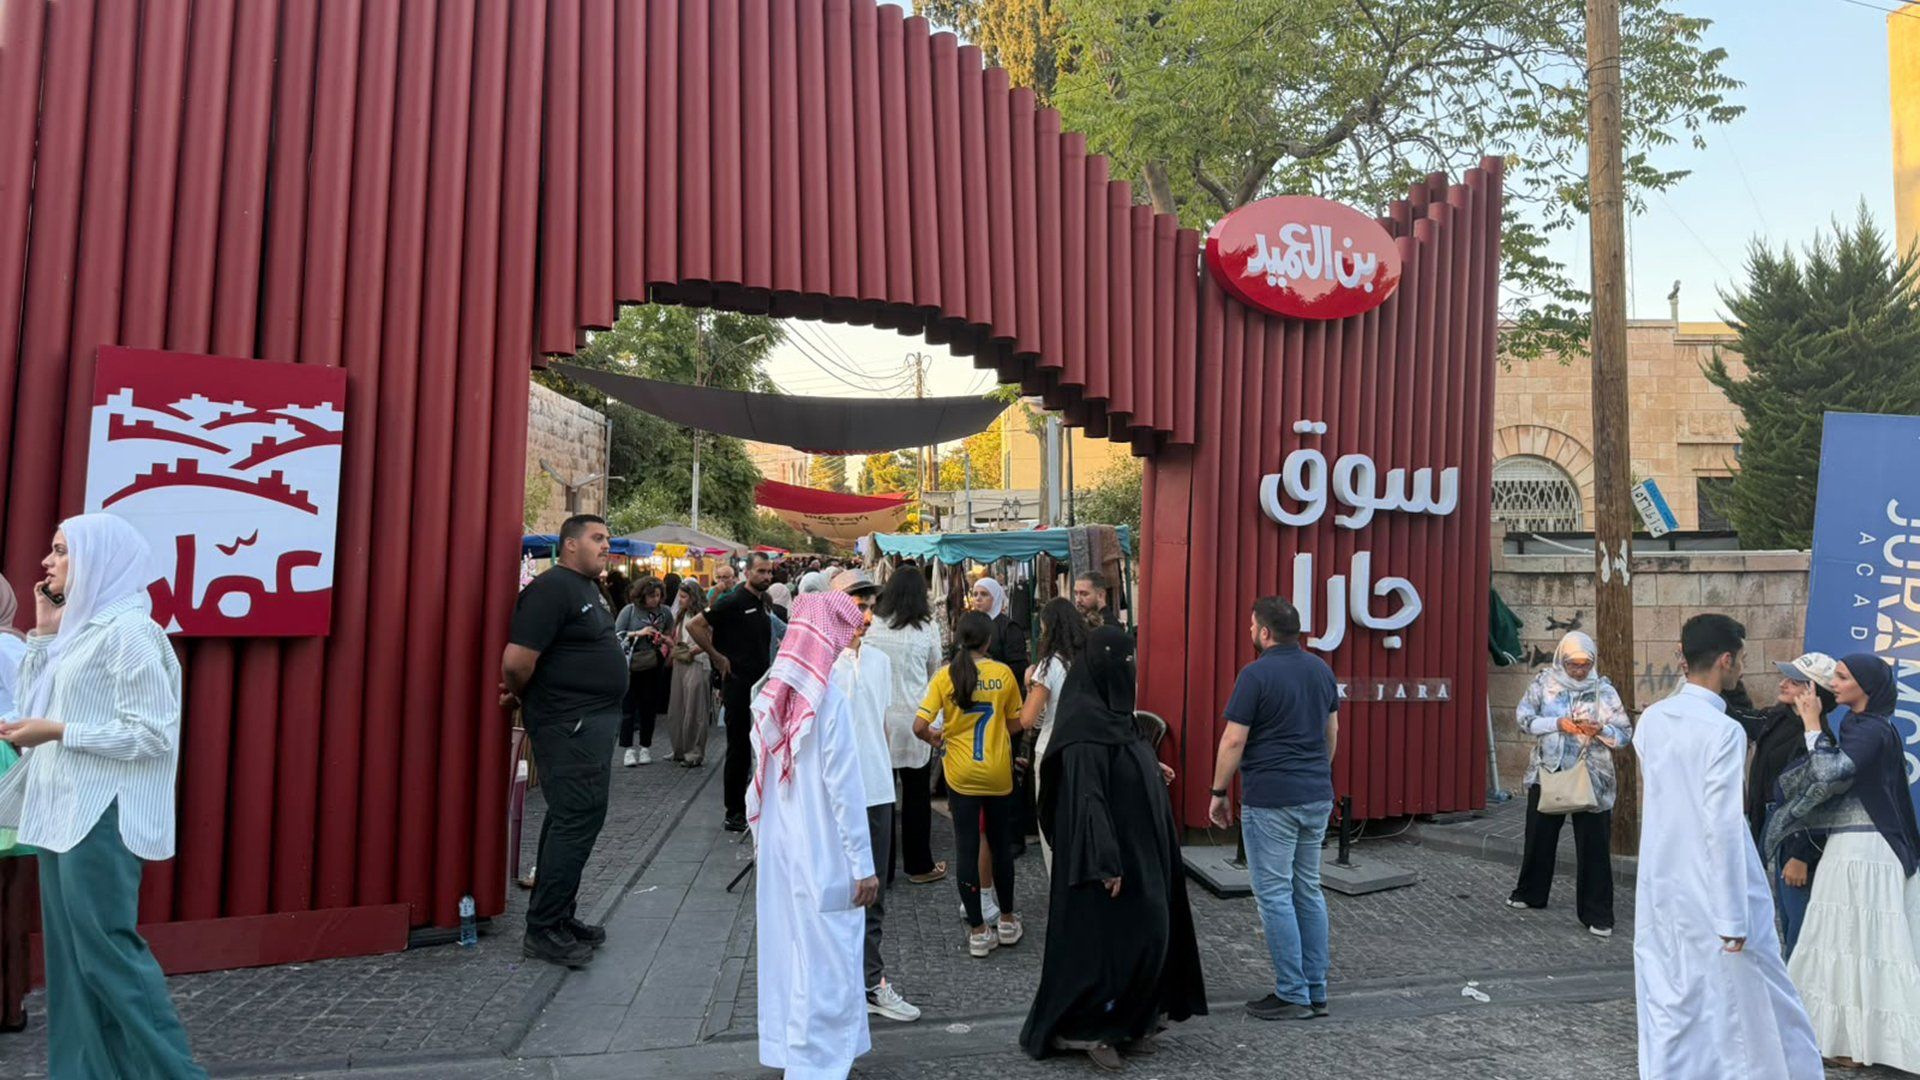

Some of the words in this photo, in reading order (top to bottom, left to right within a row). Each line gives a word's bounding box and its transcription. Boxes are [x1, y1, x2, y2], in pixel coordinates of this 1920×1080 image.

[1247, 223, 1334, 287] العميد
[1335, 237, 1376, 293] بن
[1260, 420, 1459, 529] سوق
[1293, 551, 1423, 651] جارا
[1377, 683, 1448, 701] JARA
[963, 701, 995, 762] 7
